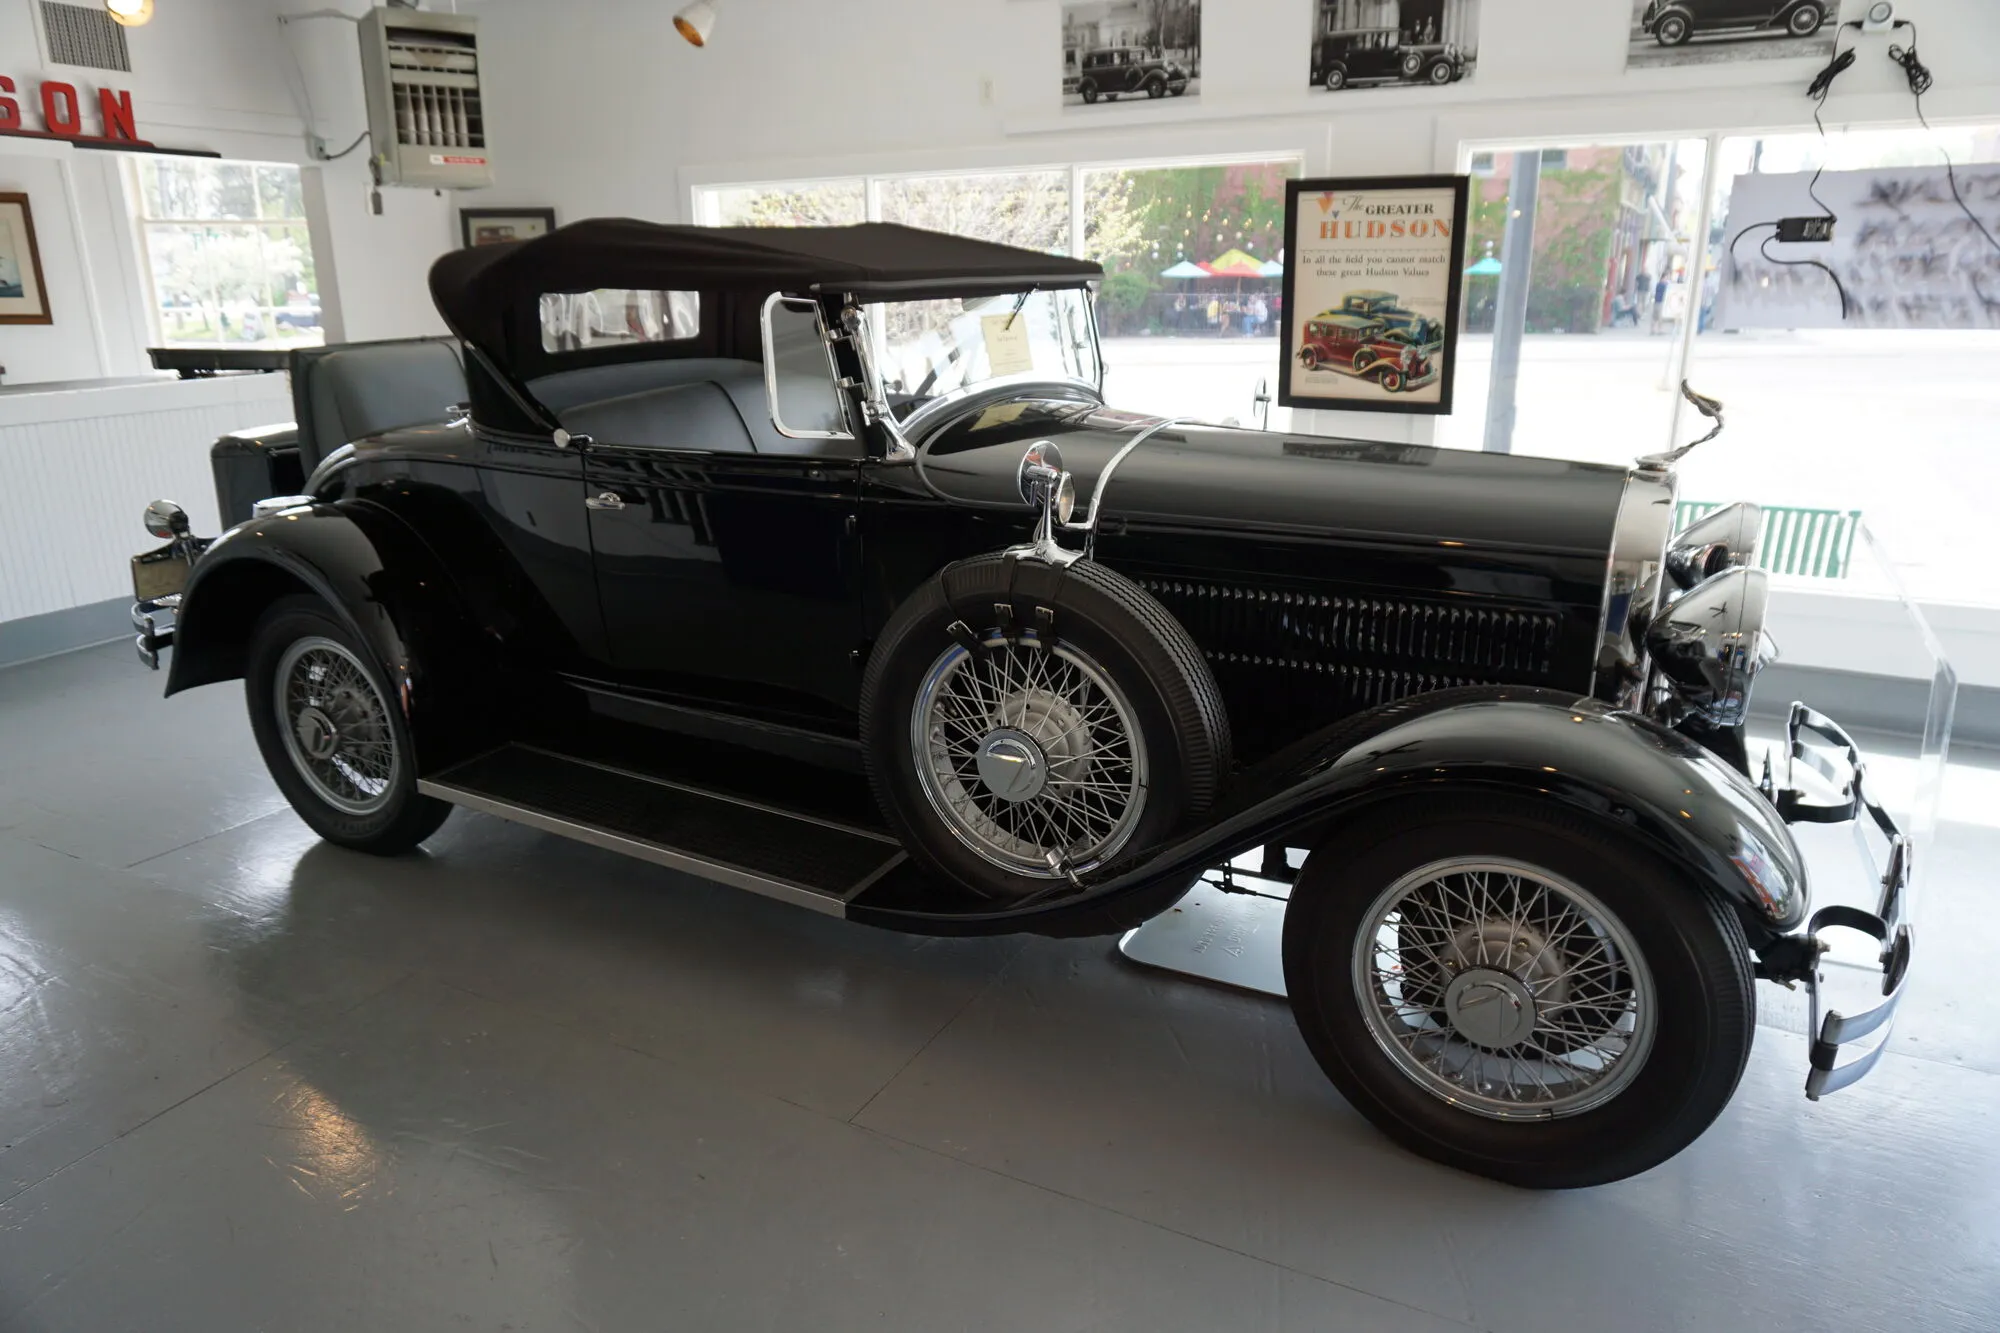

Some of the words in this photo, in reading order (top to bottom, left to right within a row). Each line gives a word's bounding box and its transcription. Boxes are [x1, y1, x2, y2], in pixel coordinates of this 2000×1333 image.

[1365, 203, 1434, 216] GREATER
[1319, 218, 1451, 239] HUDSON
[1302, 255, 1312, 264] In
[1315, 255, 1325, 264] all
[1328, 255, 1341, 264] the
[1345, 254, 1364, 264] field
[1366, 256, 1383, 267] you
[1386, 256, 1415, 264] cannot
[1419, 255, 1446, 264] match
[1316, 267, 1337, 276] these
[1340, 268, 1362, 278] great
[1366, 267, 1399, 276] Hudson
[1402, 267, 1430, 276] Values
